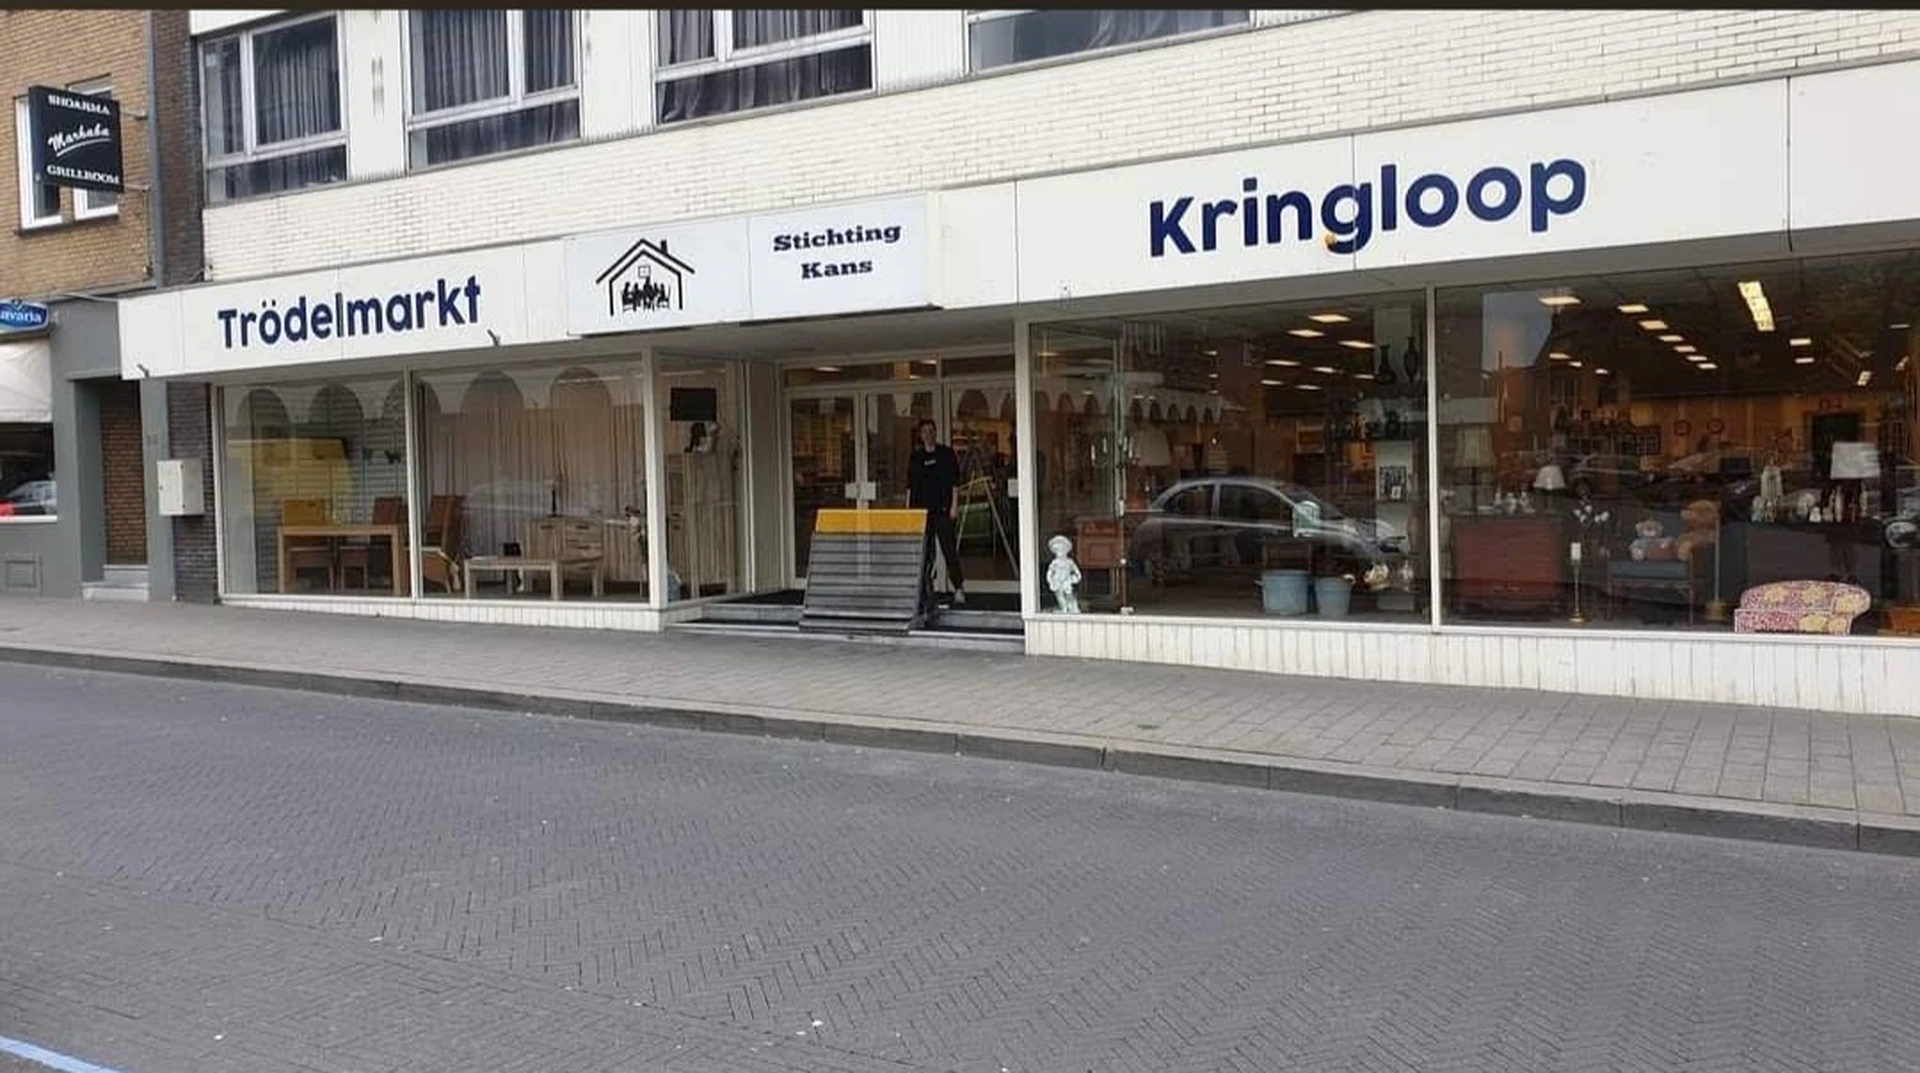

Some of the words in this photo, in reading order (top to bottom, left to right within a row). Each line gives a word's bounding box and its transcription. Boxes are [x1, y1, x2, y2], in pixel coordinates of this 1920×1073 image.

[46, 165, 119, 184] GRILLROOM
[1150, 159, 1587, 257] Kringloop
[773, 225, 902, 252] Stichting
[801, 260, 873, 279] Kans
[0, 310, 43, 323] avaria
[217, 275, 481, 349] Trödelmarkt
